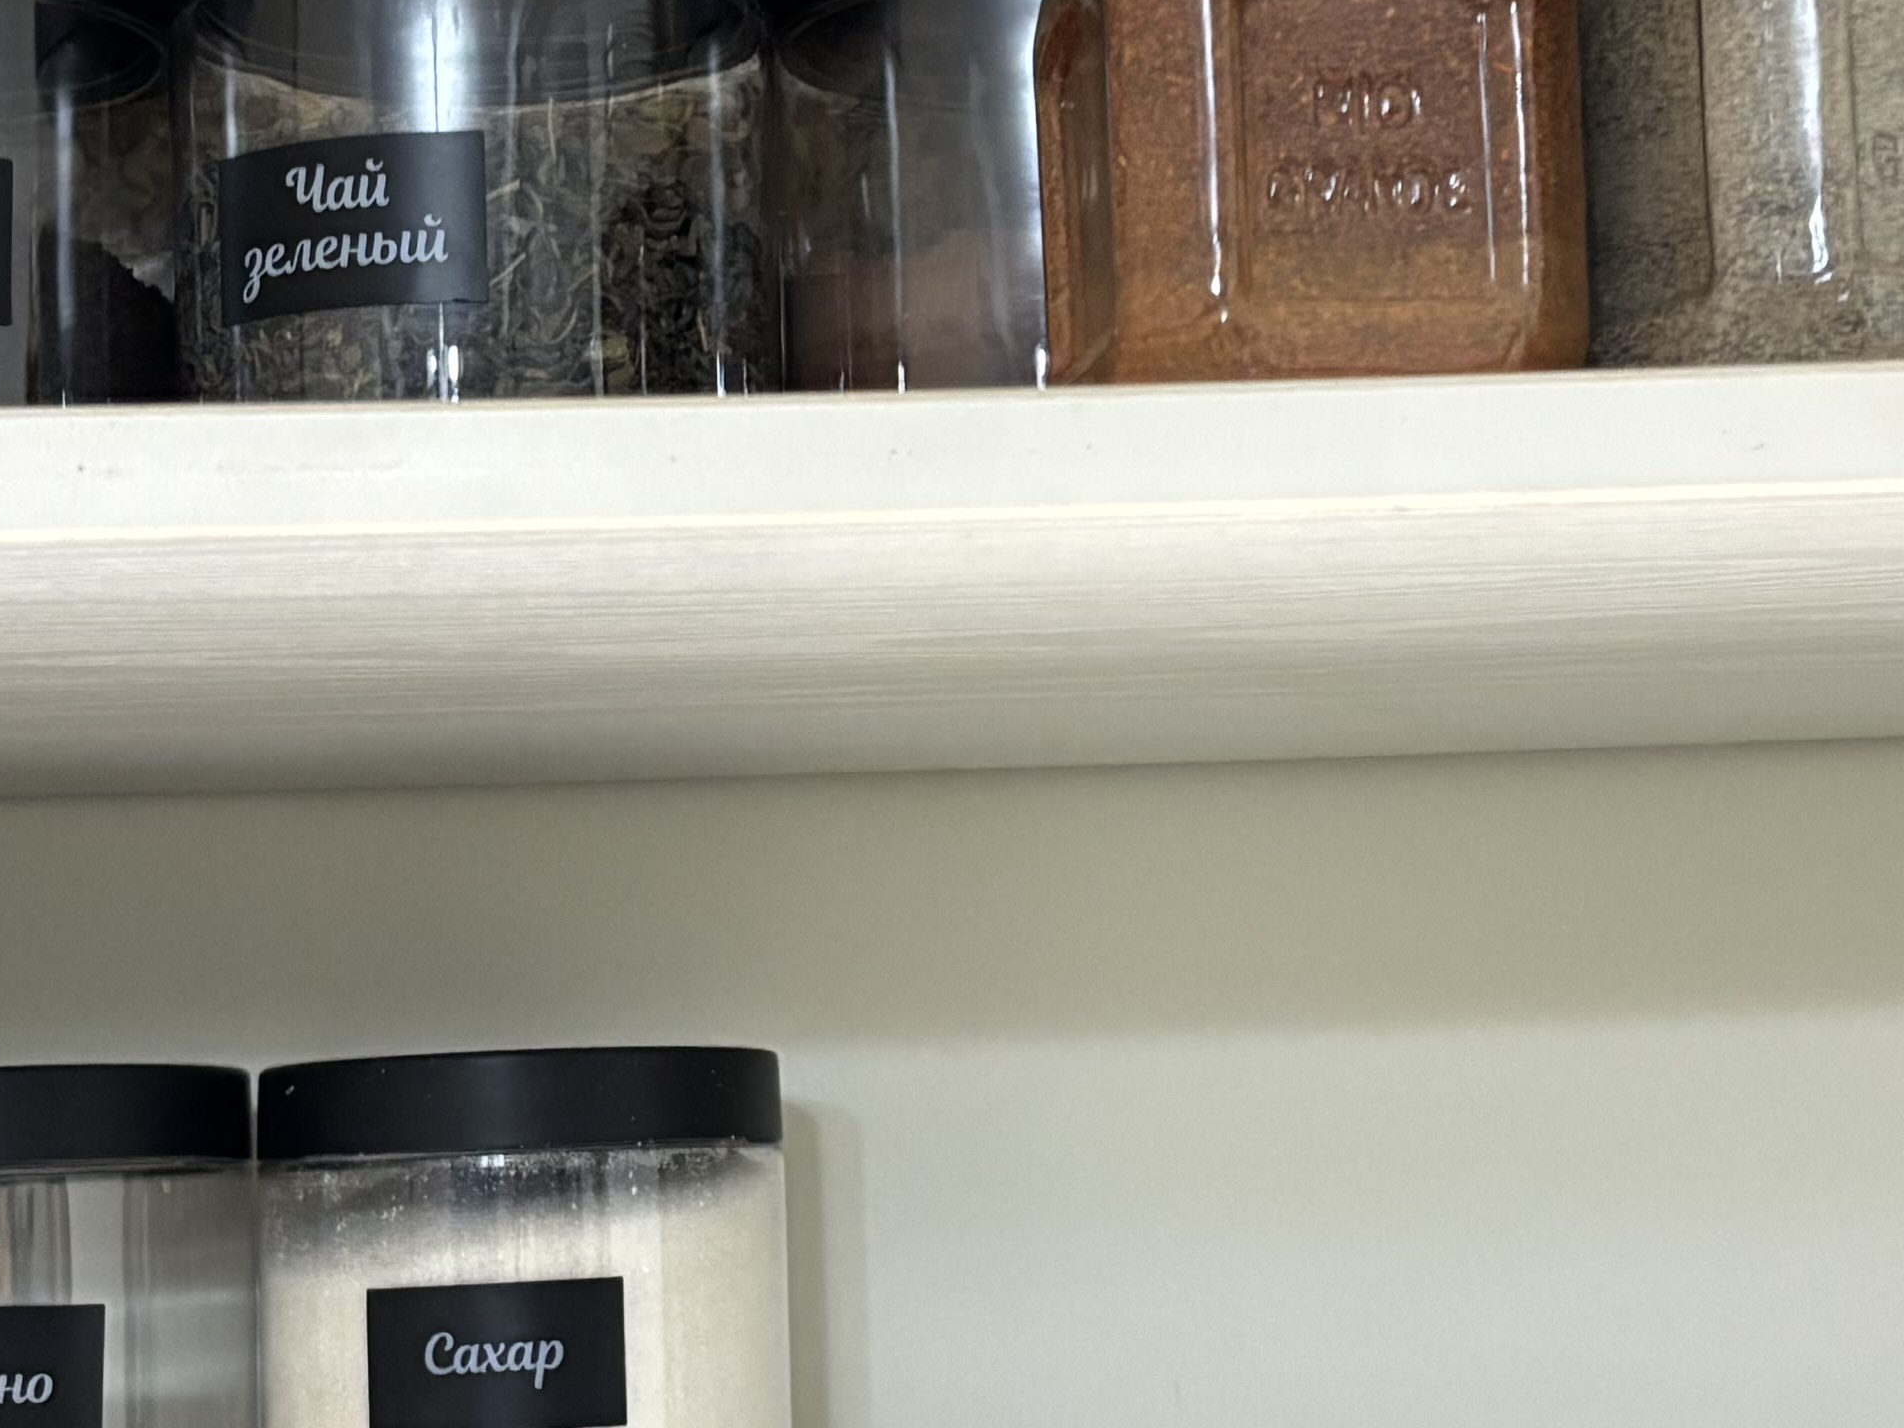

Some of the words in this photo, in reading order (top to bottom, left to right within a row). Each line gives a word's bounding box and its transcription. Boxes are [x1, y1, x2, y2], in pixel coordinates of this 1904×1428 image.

[286, 158, 390, 213] Чай
[243, 213, 449, 304] зеленый
[424, 1332, 564, 1389] Сахар
